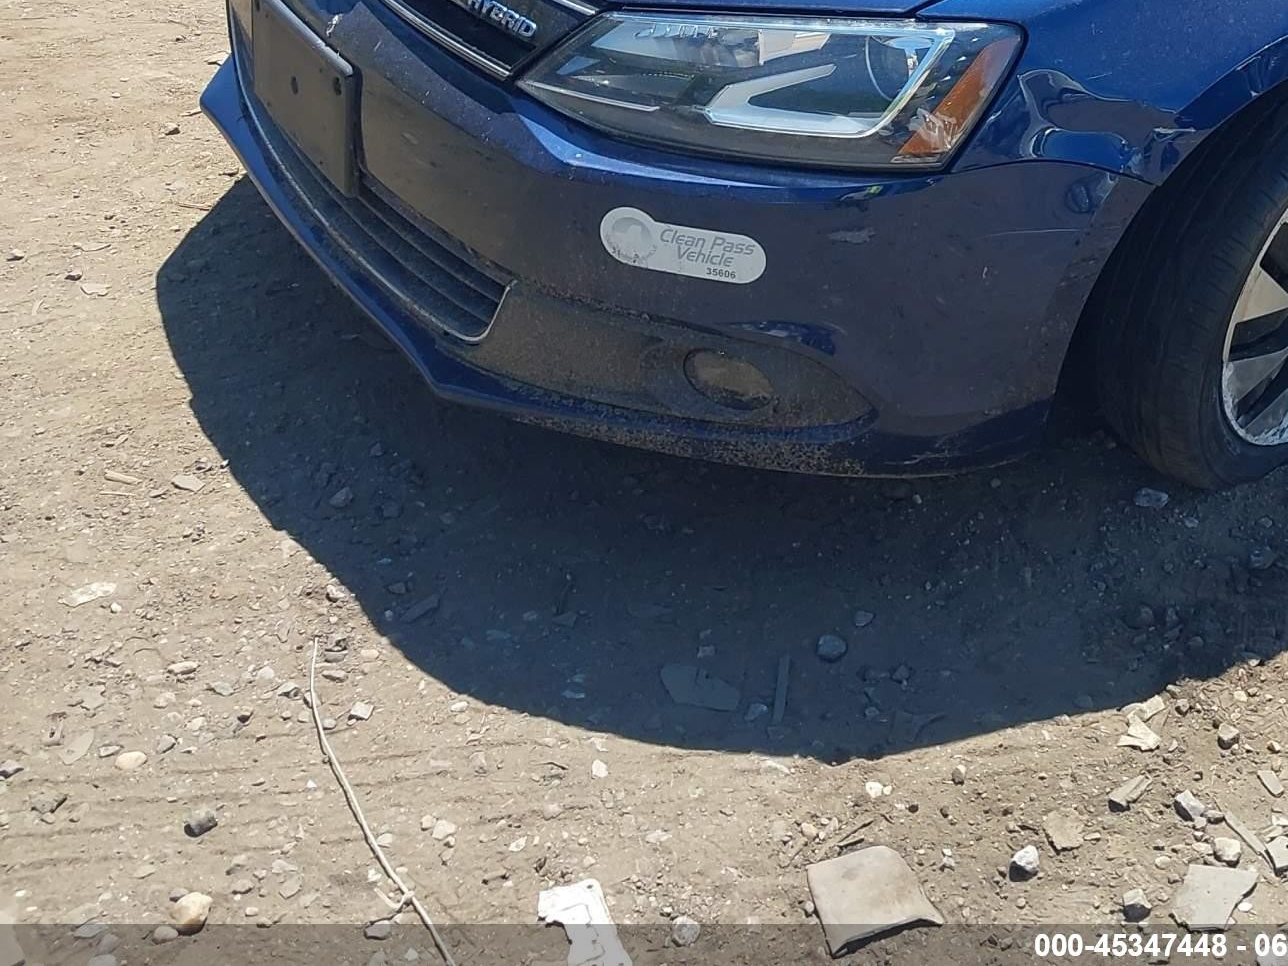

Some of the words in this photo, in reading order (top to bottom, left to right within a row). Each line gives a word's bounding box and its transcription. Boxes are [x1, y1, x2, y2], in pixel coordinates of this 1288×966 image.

[660, 228, 705, 248] Clean
[710, 236, 755, 255] Pass
[677, 246, 734, 268] Vehicle
[706, 267, 736, 279] 35606
